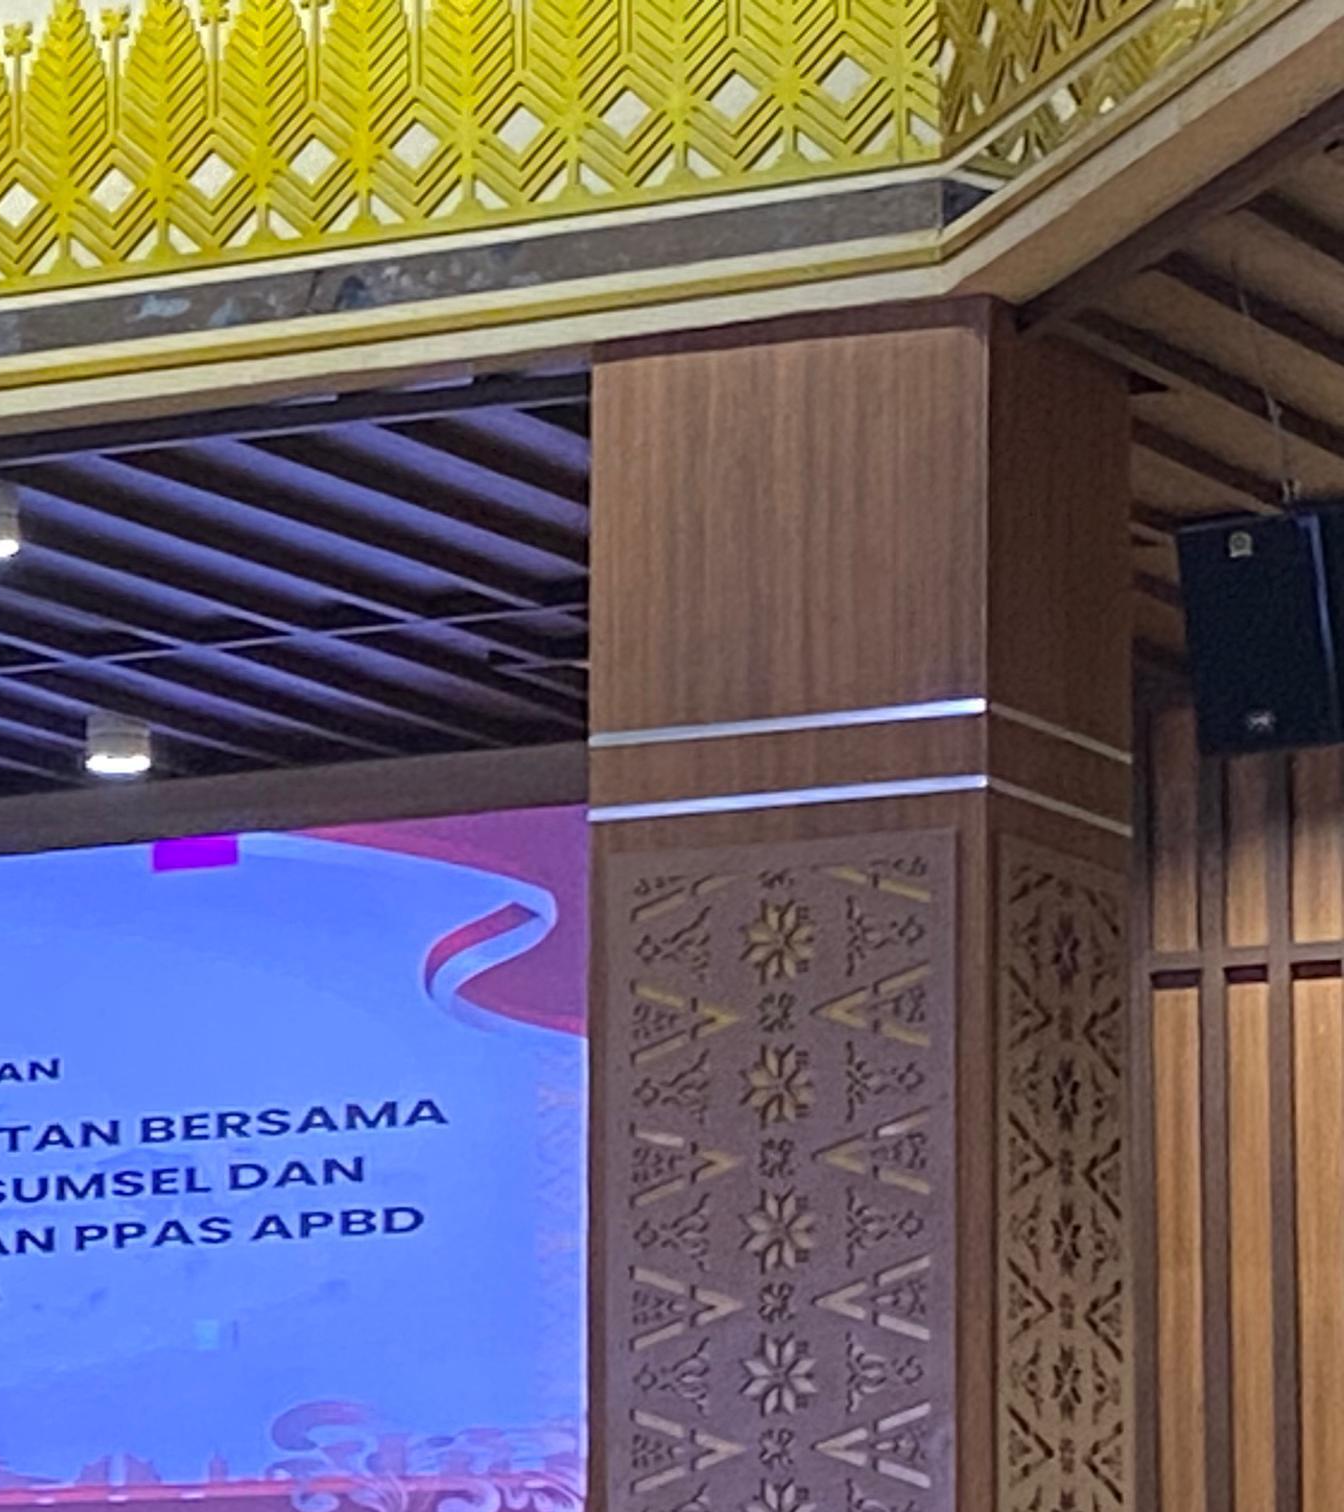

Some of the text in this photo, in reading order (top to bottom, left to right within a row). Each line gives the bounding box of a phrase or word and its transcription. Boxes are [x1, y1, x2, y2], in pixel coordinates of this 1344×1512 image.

[140, 1099, 448, 1144] BERSAMA
[228, 1156, 364, 1191] DAN
[74, 1216, 232, 1252] PPAS
[251, 1206, 425, 1241] APBD
